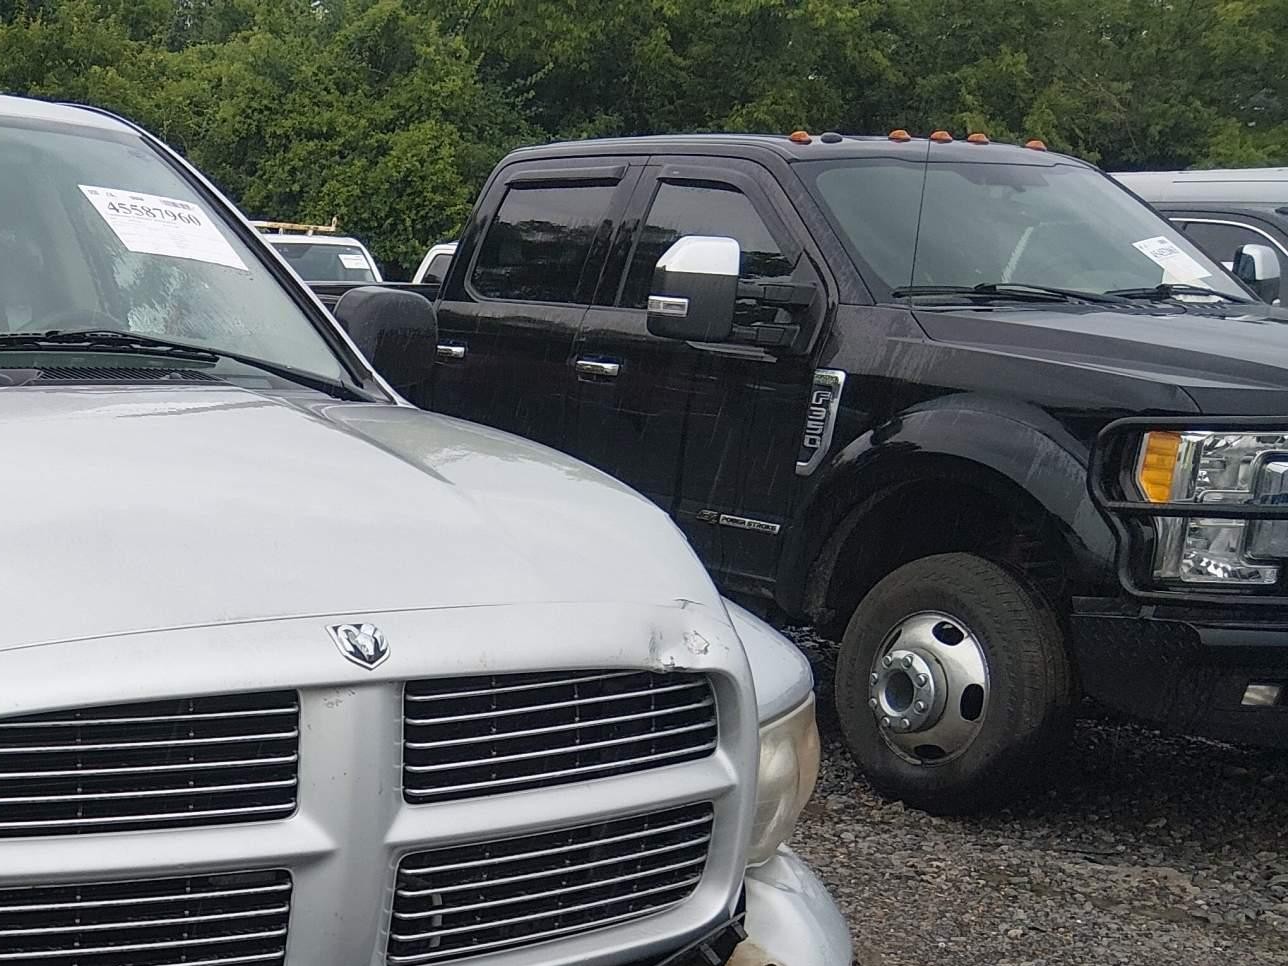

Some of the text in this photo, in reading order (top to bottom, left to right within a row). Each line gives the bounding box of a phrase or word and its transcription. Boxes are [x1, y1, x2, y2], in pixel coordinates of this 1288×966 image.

[107, 201, 202, 227] 45587960
[803, 390, 832, 448] F350
[746, 520, 778, 532] STROKE
